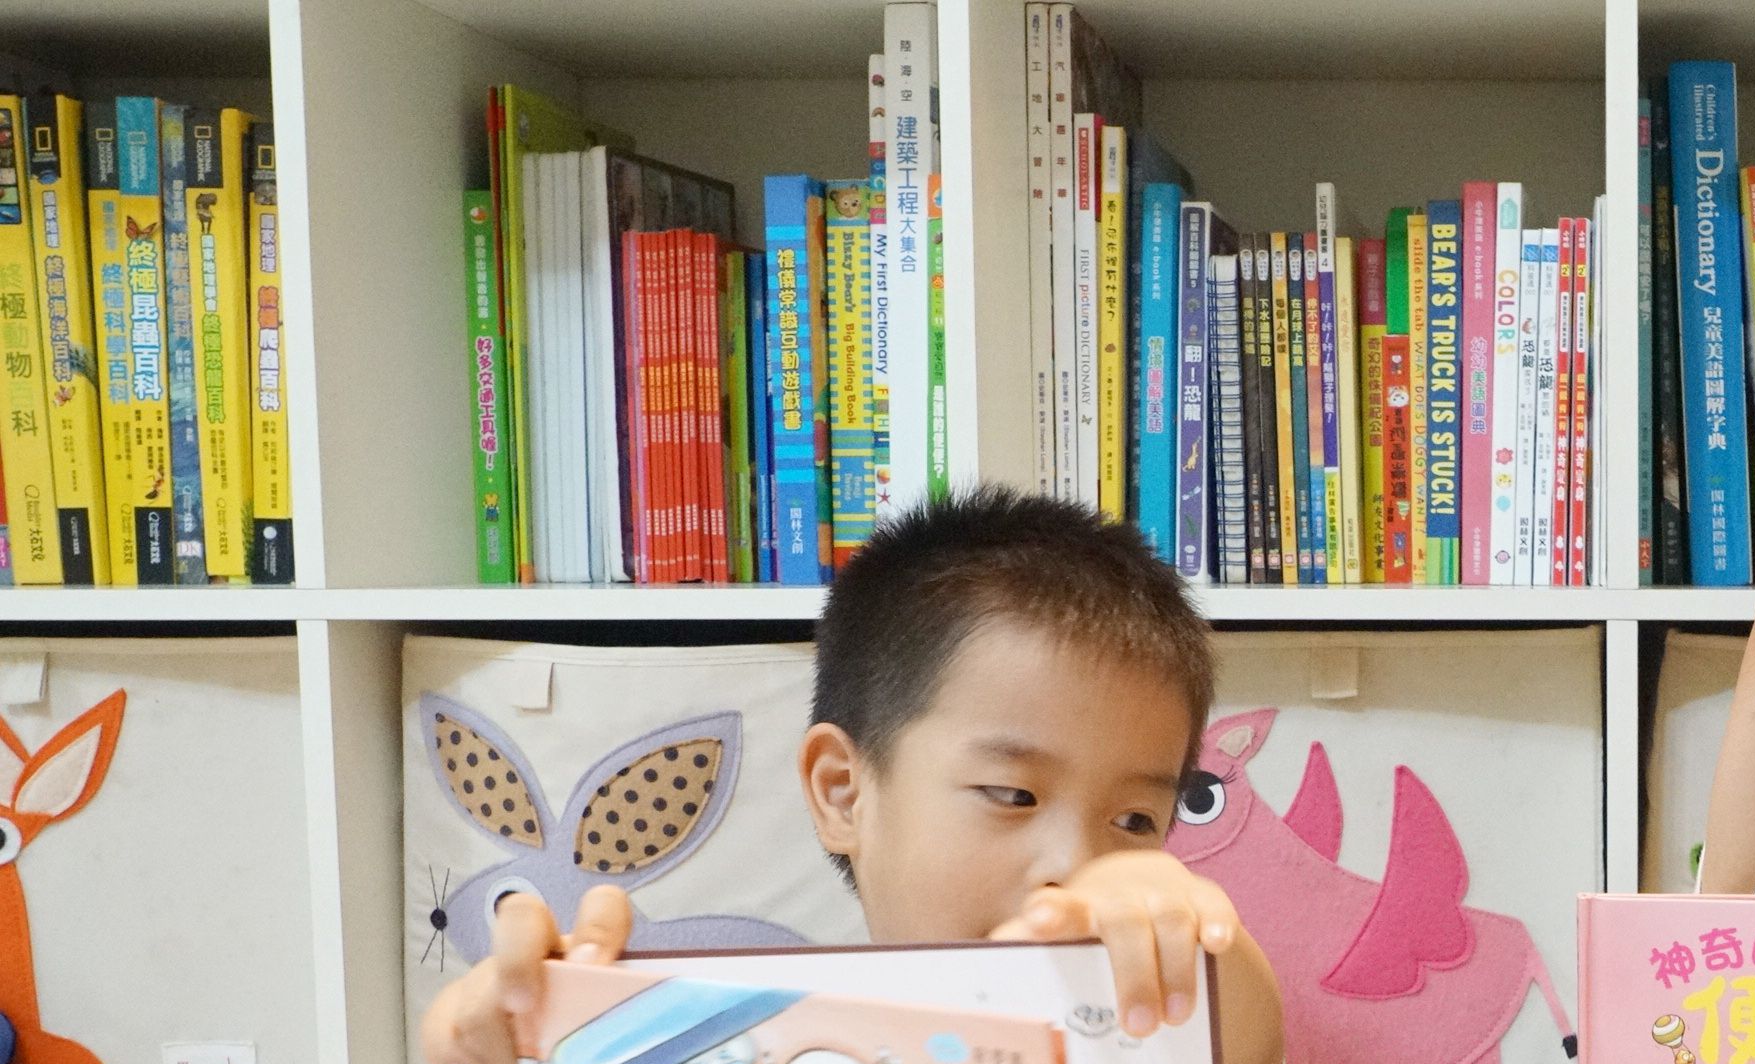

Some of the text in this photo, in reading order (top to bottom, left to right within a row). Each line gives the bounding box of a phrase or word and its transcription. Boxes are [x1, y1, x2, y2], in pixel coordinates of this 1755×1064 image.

[1694, 84, 1705, 141] Illustrated
[1706, 84, 1717, 141] Children's
[896, 115, 918, 274] 建築工程大集合
[1079, 138, 1089, 209] SCHOLASTIC
[1694, 148, 1724, 296] Dictionary
[127, 238, 164, 402] 終極昆蟲百科
[842, 230, 857, 425] Bizzy Bear's Big Building Book
[874, 233, 889, 375] My First Dictionary
[1079, 249, 1092, 406] FIRST picture DICTIONARY
[1413, 238, 1425, 332] slide the tab
[1497, 269, 1518, 356] COLORS
[1414, 341, 1425, 381] WHAT
[1414, 386, 1425, 423] DOES
[1431, 223, 1457, 516] BEAR'S TRUCK IS STUCK!
[1703, 306, 1727, 451] 兒童美語圖解字典
[1413, 424, 1427, 482] DOGGY
